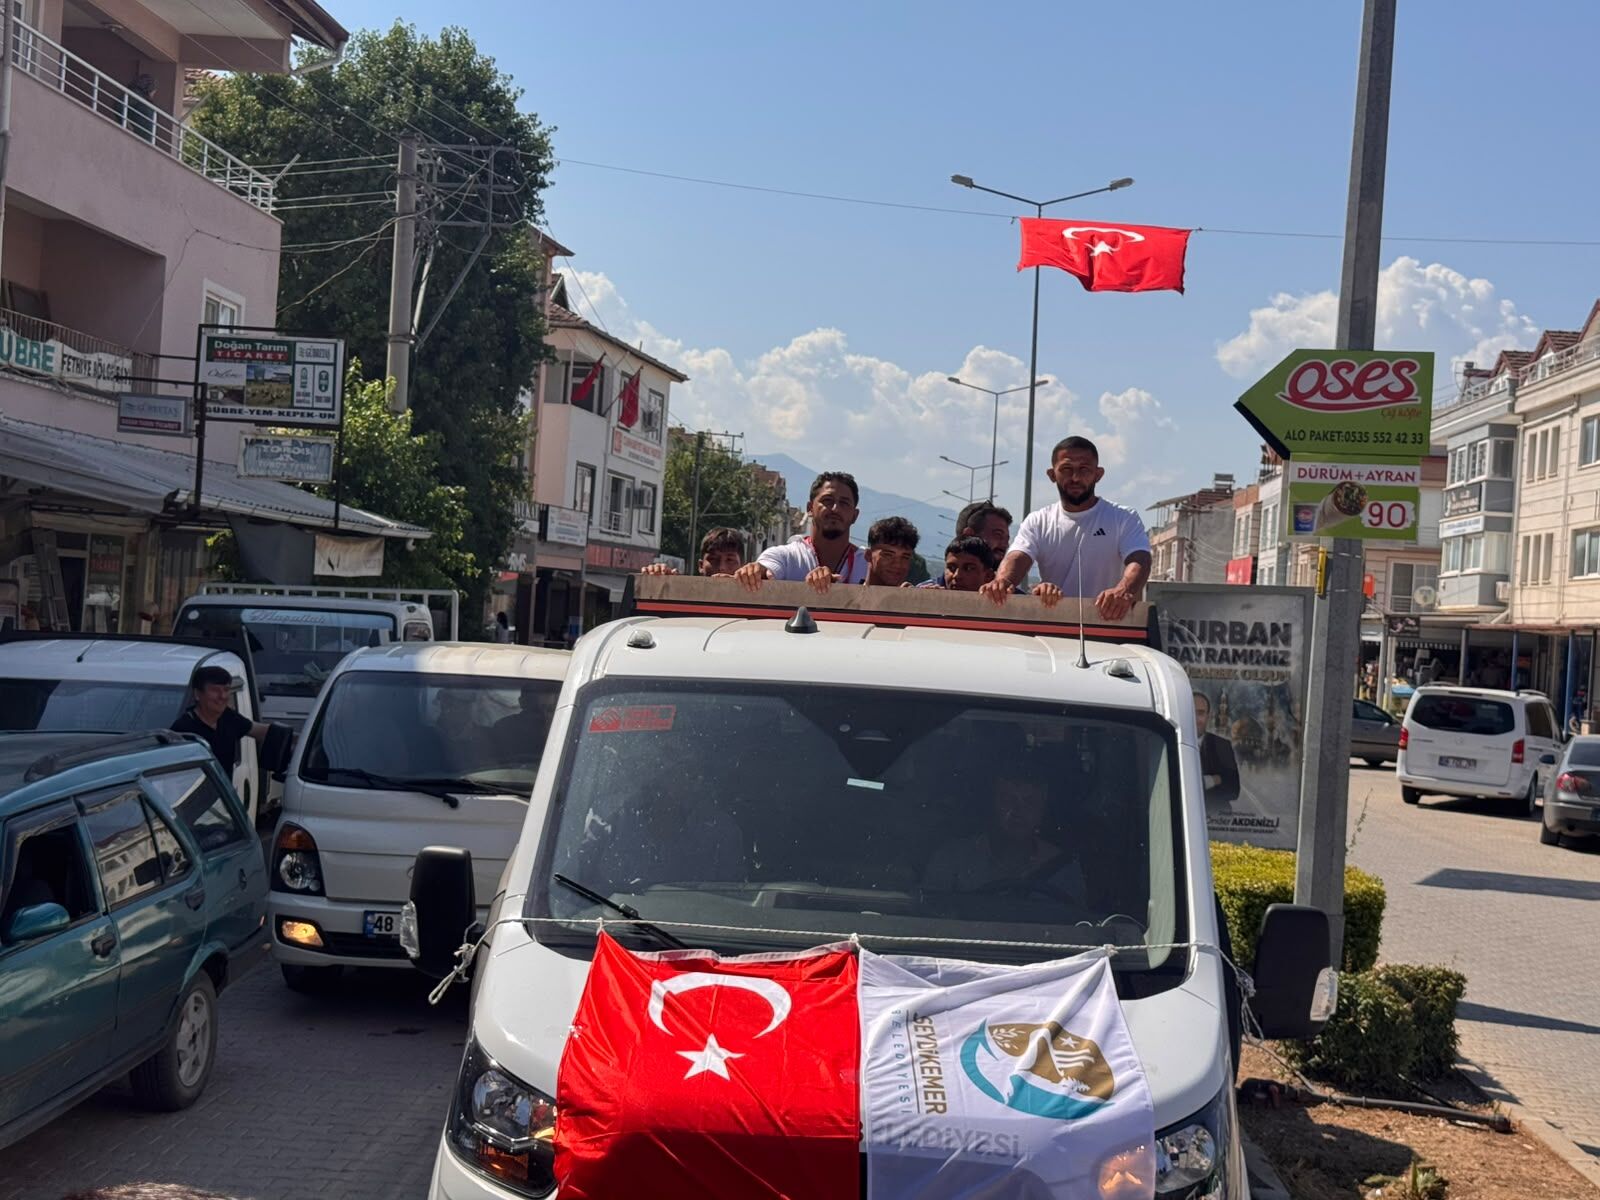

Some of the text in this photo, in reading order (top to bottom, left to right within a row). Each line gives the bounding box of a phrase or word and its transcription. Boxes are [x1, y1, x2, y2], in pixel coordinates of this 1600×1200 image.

[214, 340, 288, 352] Doğan Tarım
[217, 350, 284, 360] TİCARET
[1285, 359, 1419, 402] oses
[1284, 429, 1424, 445] ALO PAKET:0535 552 42 33
[1367, 501, 1406, 528] 90
[1168, 619, 1292, 648] KURBAN
[374, 915, 394, 932] 48
[913, 1012, 947, 1115] SEYDİKEMER
